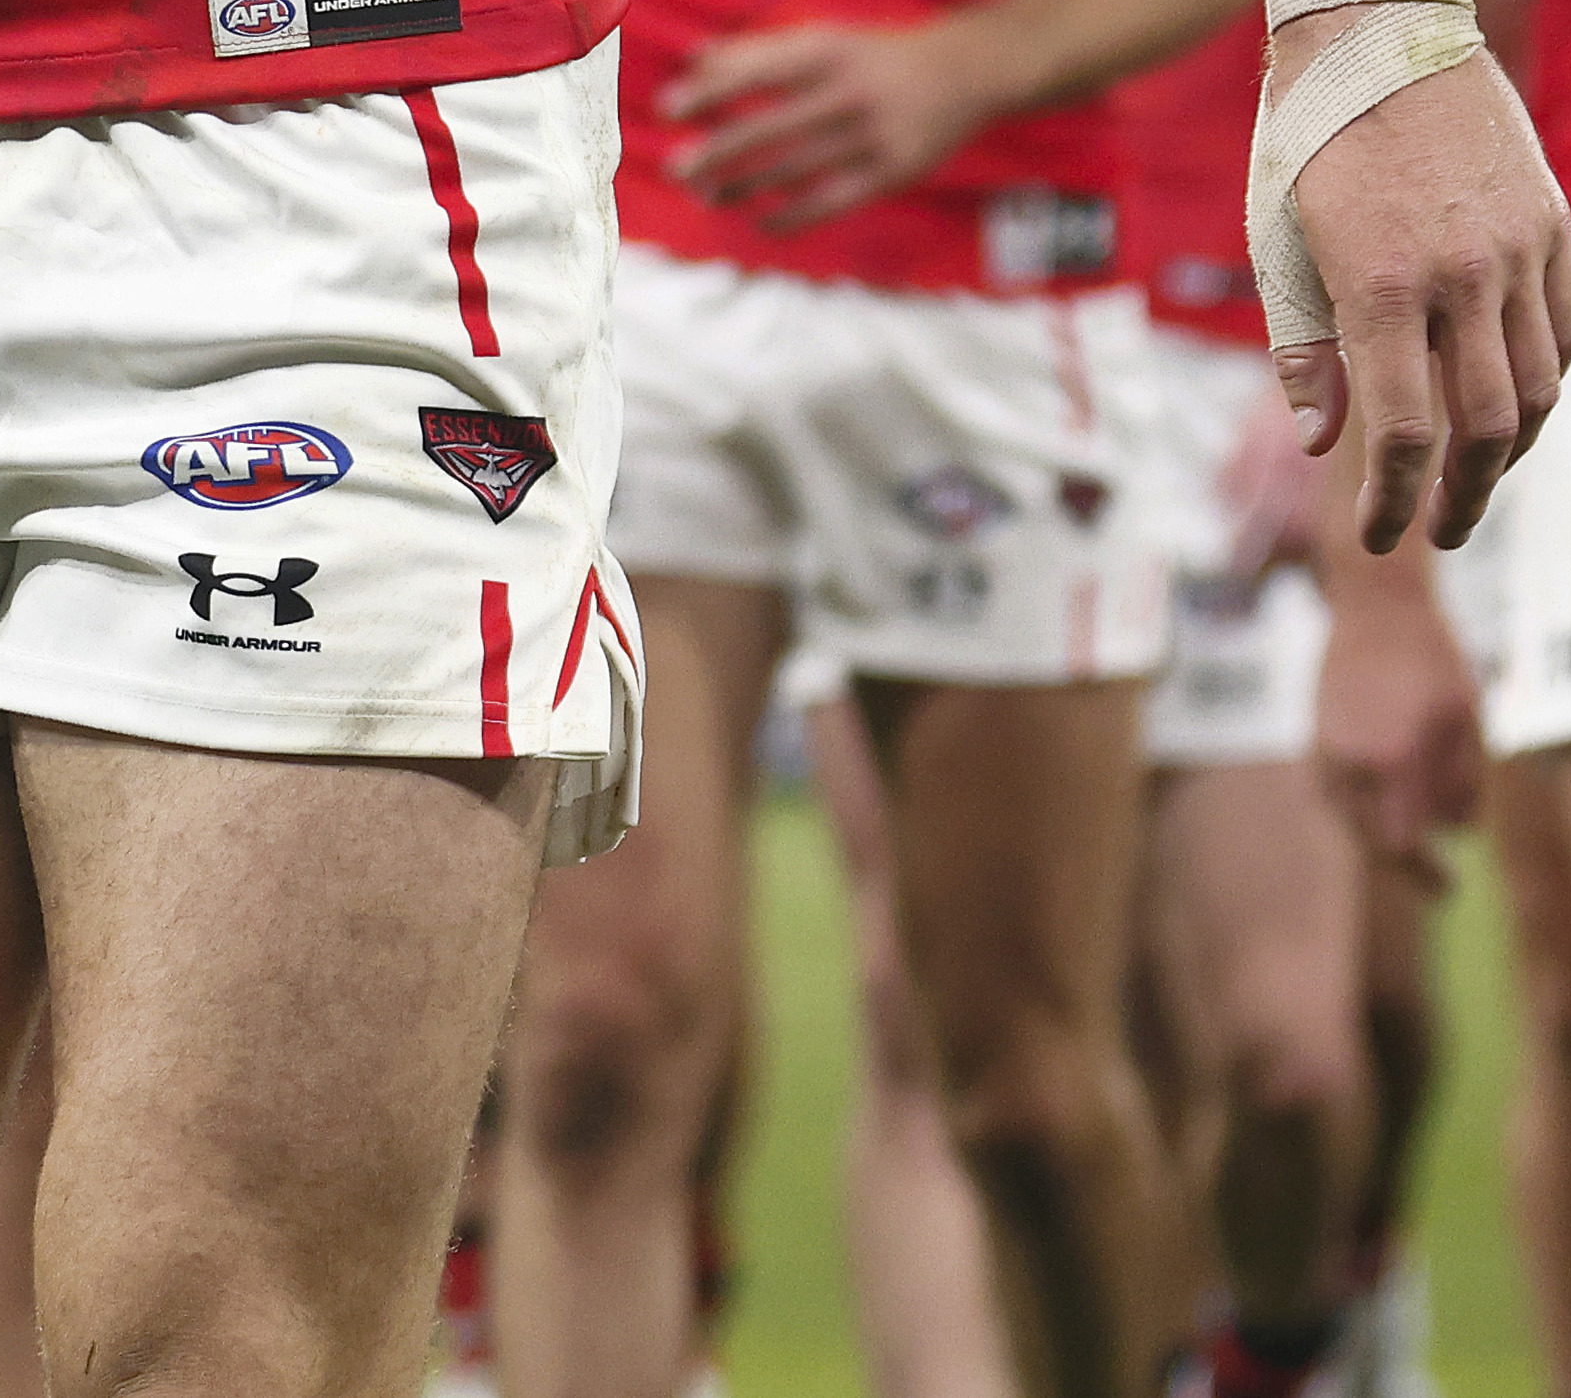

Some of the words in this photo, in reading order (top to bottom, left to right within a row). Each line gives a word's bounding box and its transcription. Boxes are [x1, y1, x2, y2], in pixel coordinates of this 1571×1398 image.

[227, 1, 290, 30] AFL
[171, 440, 340, 486] AFL
[174, 627, 229, 648] UNDER
[231, 635, 322, 653] ARMOUR
